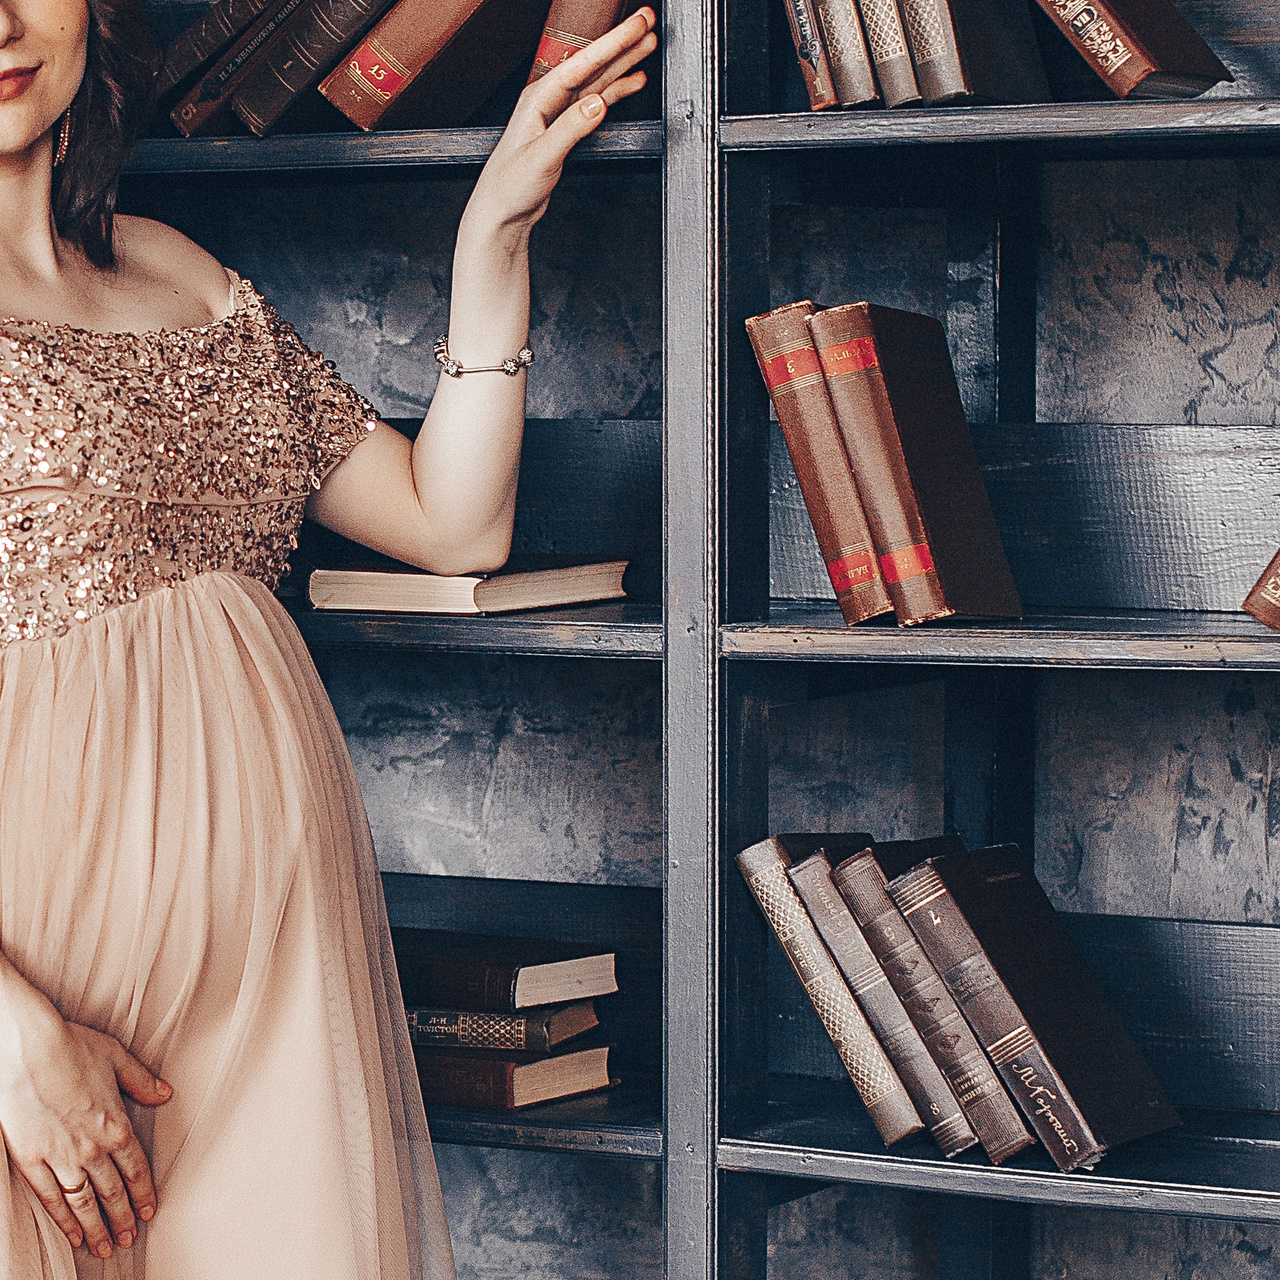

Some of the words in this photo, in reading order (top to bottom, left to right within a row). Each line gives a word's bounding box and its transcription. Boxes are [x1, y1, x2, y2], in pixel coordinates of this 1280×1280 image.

[1071, 10, 1091, 29] VII
[233, 18, 277, 67] МЕЛЬНИКОВ
[365, 61, 389, 83] 15
[178, 102, 198, 122] 5
[417, 1024, 458, 1034] ТОЛСТОЙ
